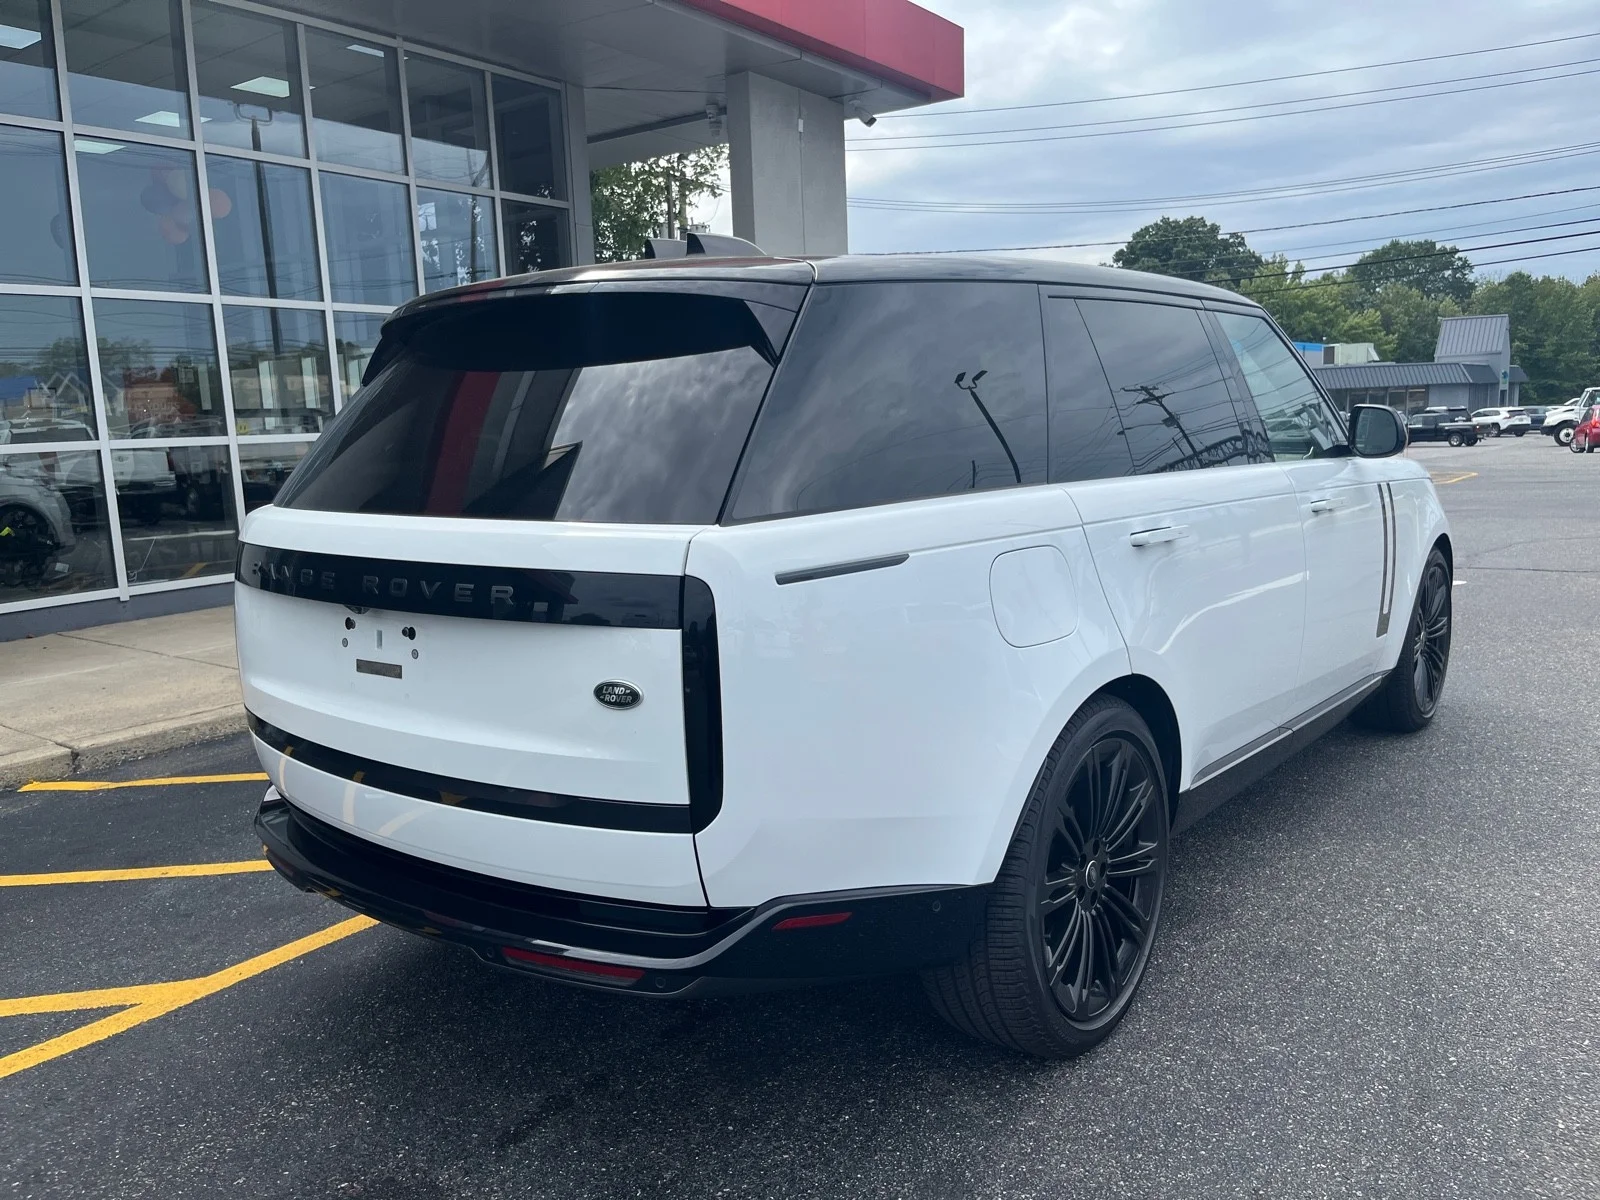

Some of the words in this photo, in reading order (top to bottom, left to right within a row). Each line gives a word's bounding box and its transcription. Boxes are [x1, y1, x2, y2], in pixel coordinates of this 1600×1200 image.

[362, 575, 514, 605] ROVER
[602, 685, 625, 695] LAND
[604, 693, 633, 703] ROVER
